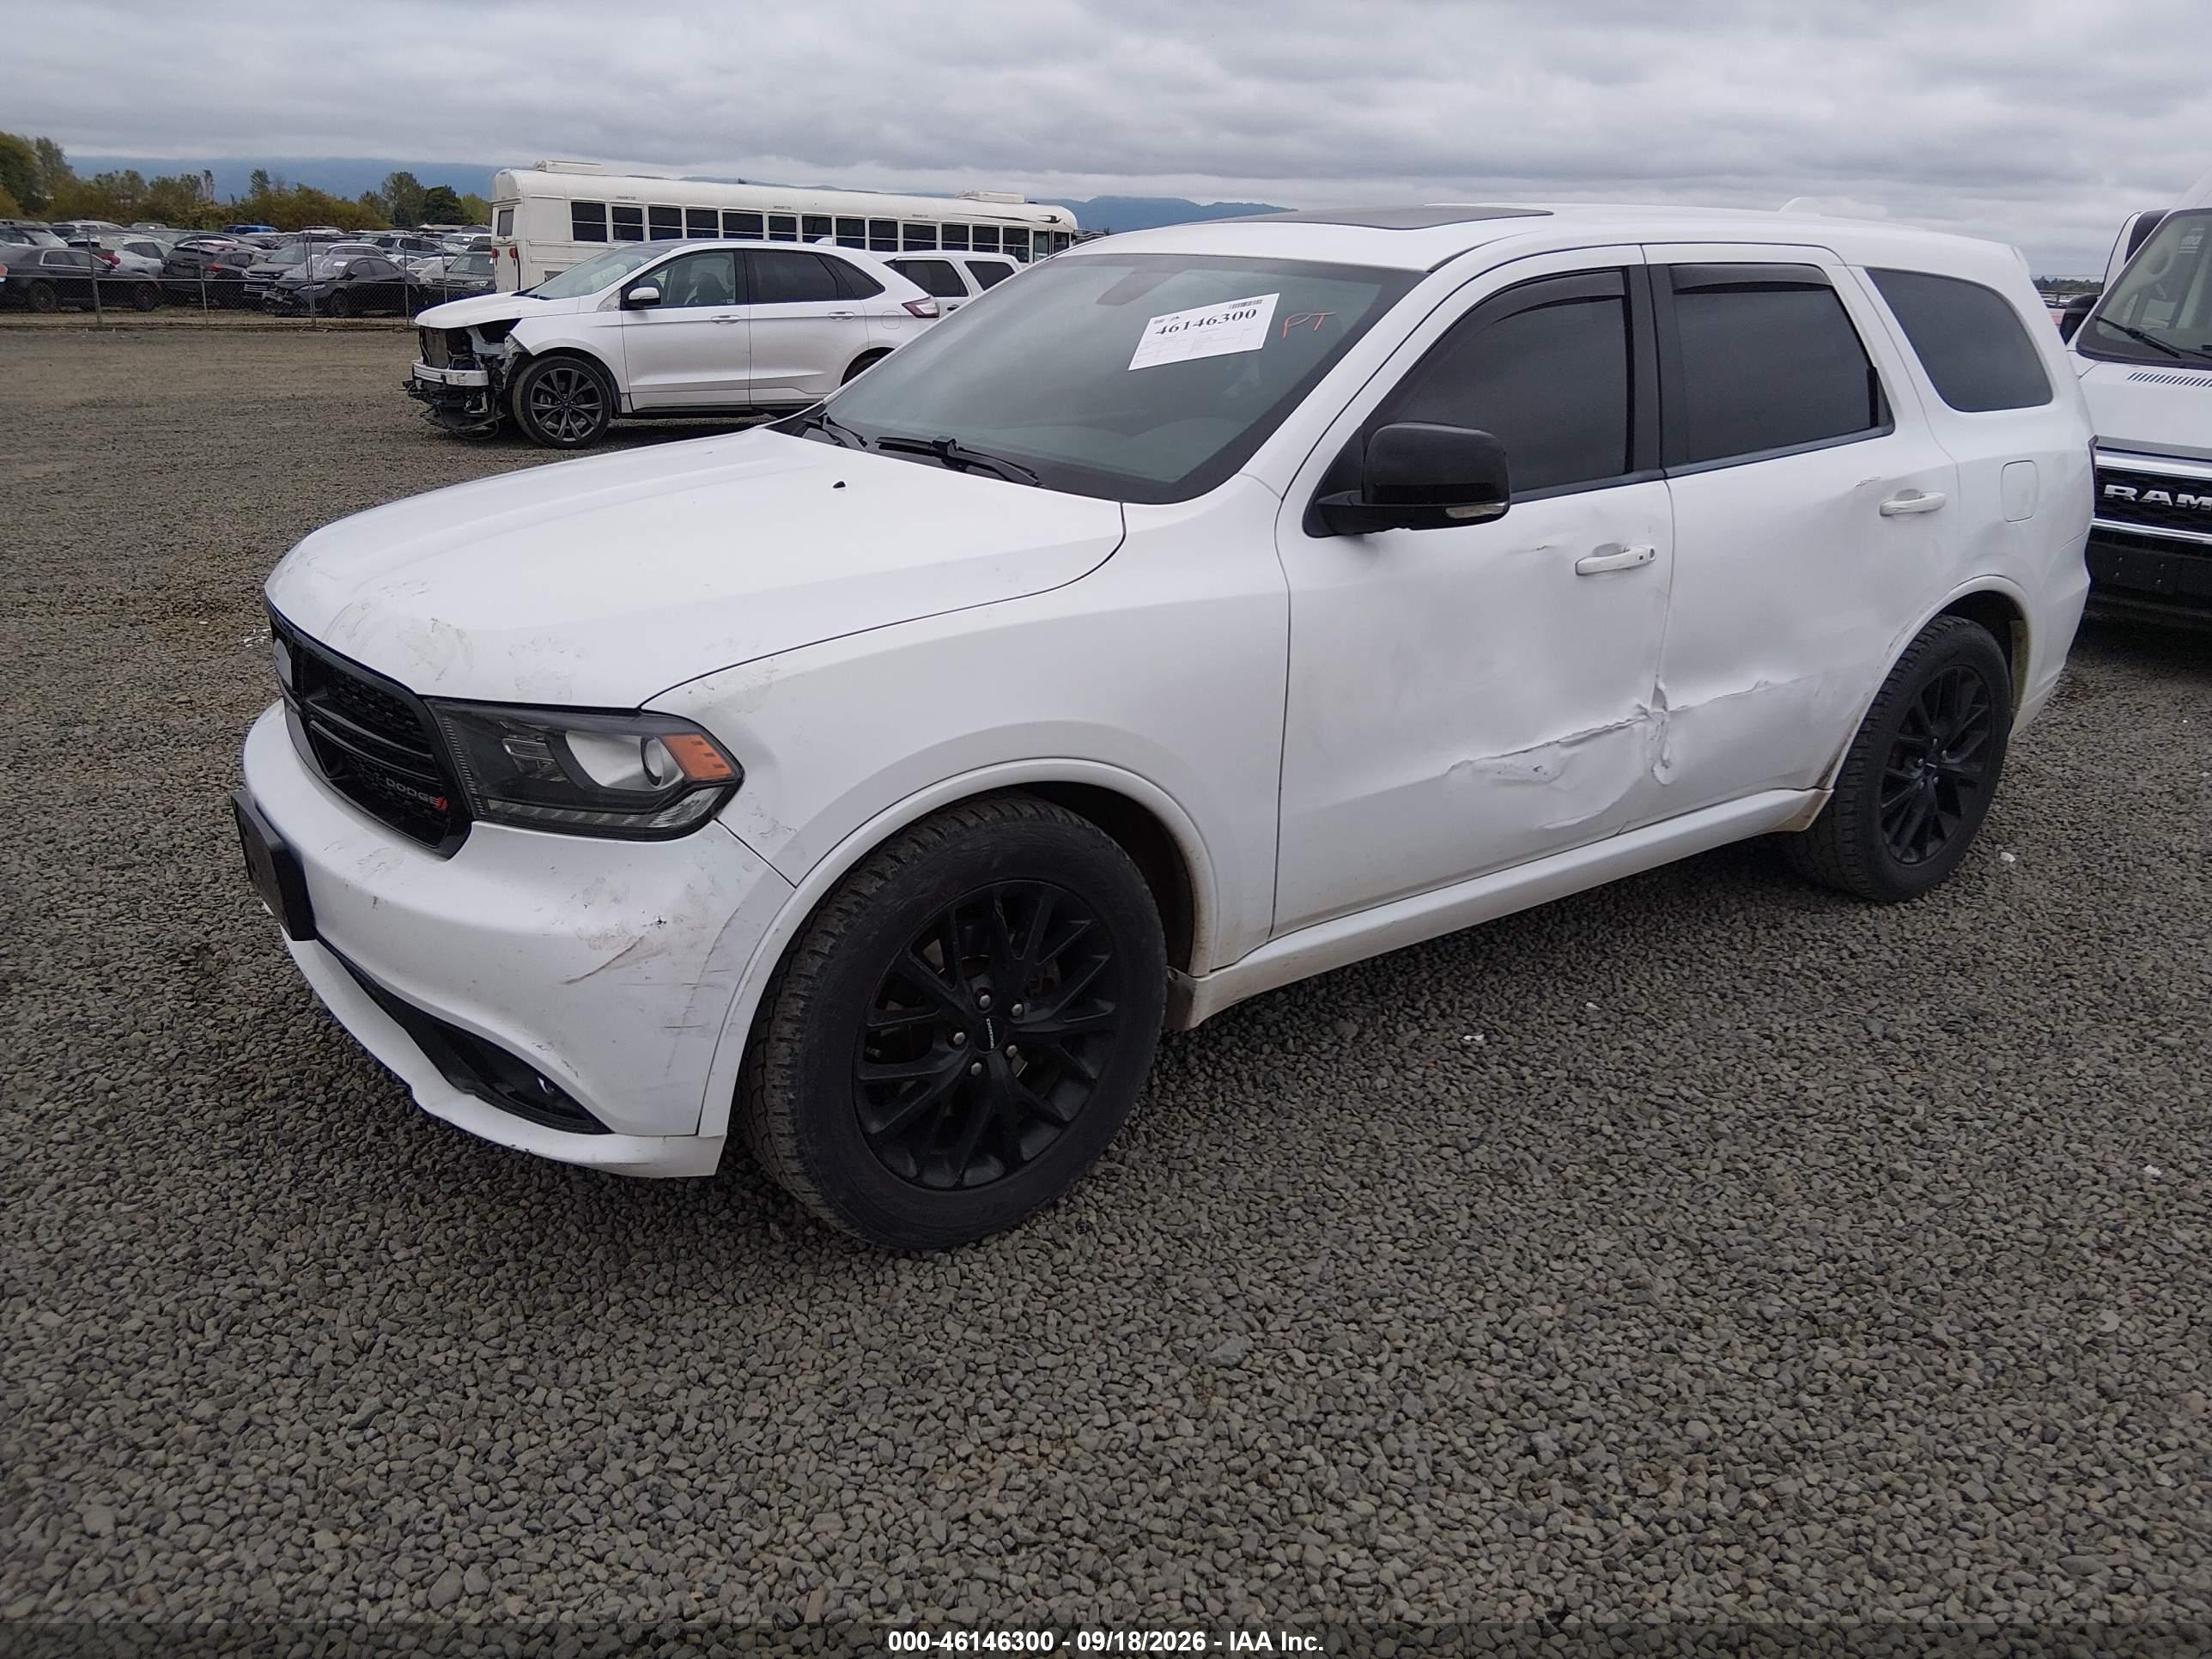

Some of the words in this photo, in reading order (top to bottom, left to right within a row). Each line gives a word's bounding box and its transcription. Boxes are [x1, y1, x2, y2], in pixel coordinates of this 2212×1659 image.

[1155, 308, 1257, 336] 46146300
[1282, 311, 1336, 338] PT
[2104, 483, 2212, 511] RAM
[386, 777, 441, 805] DODGE
